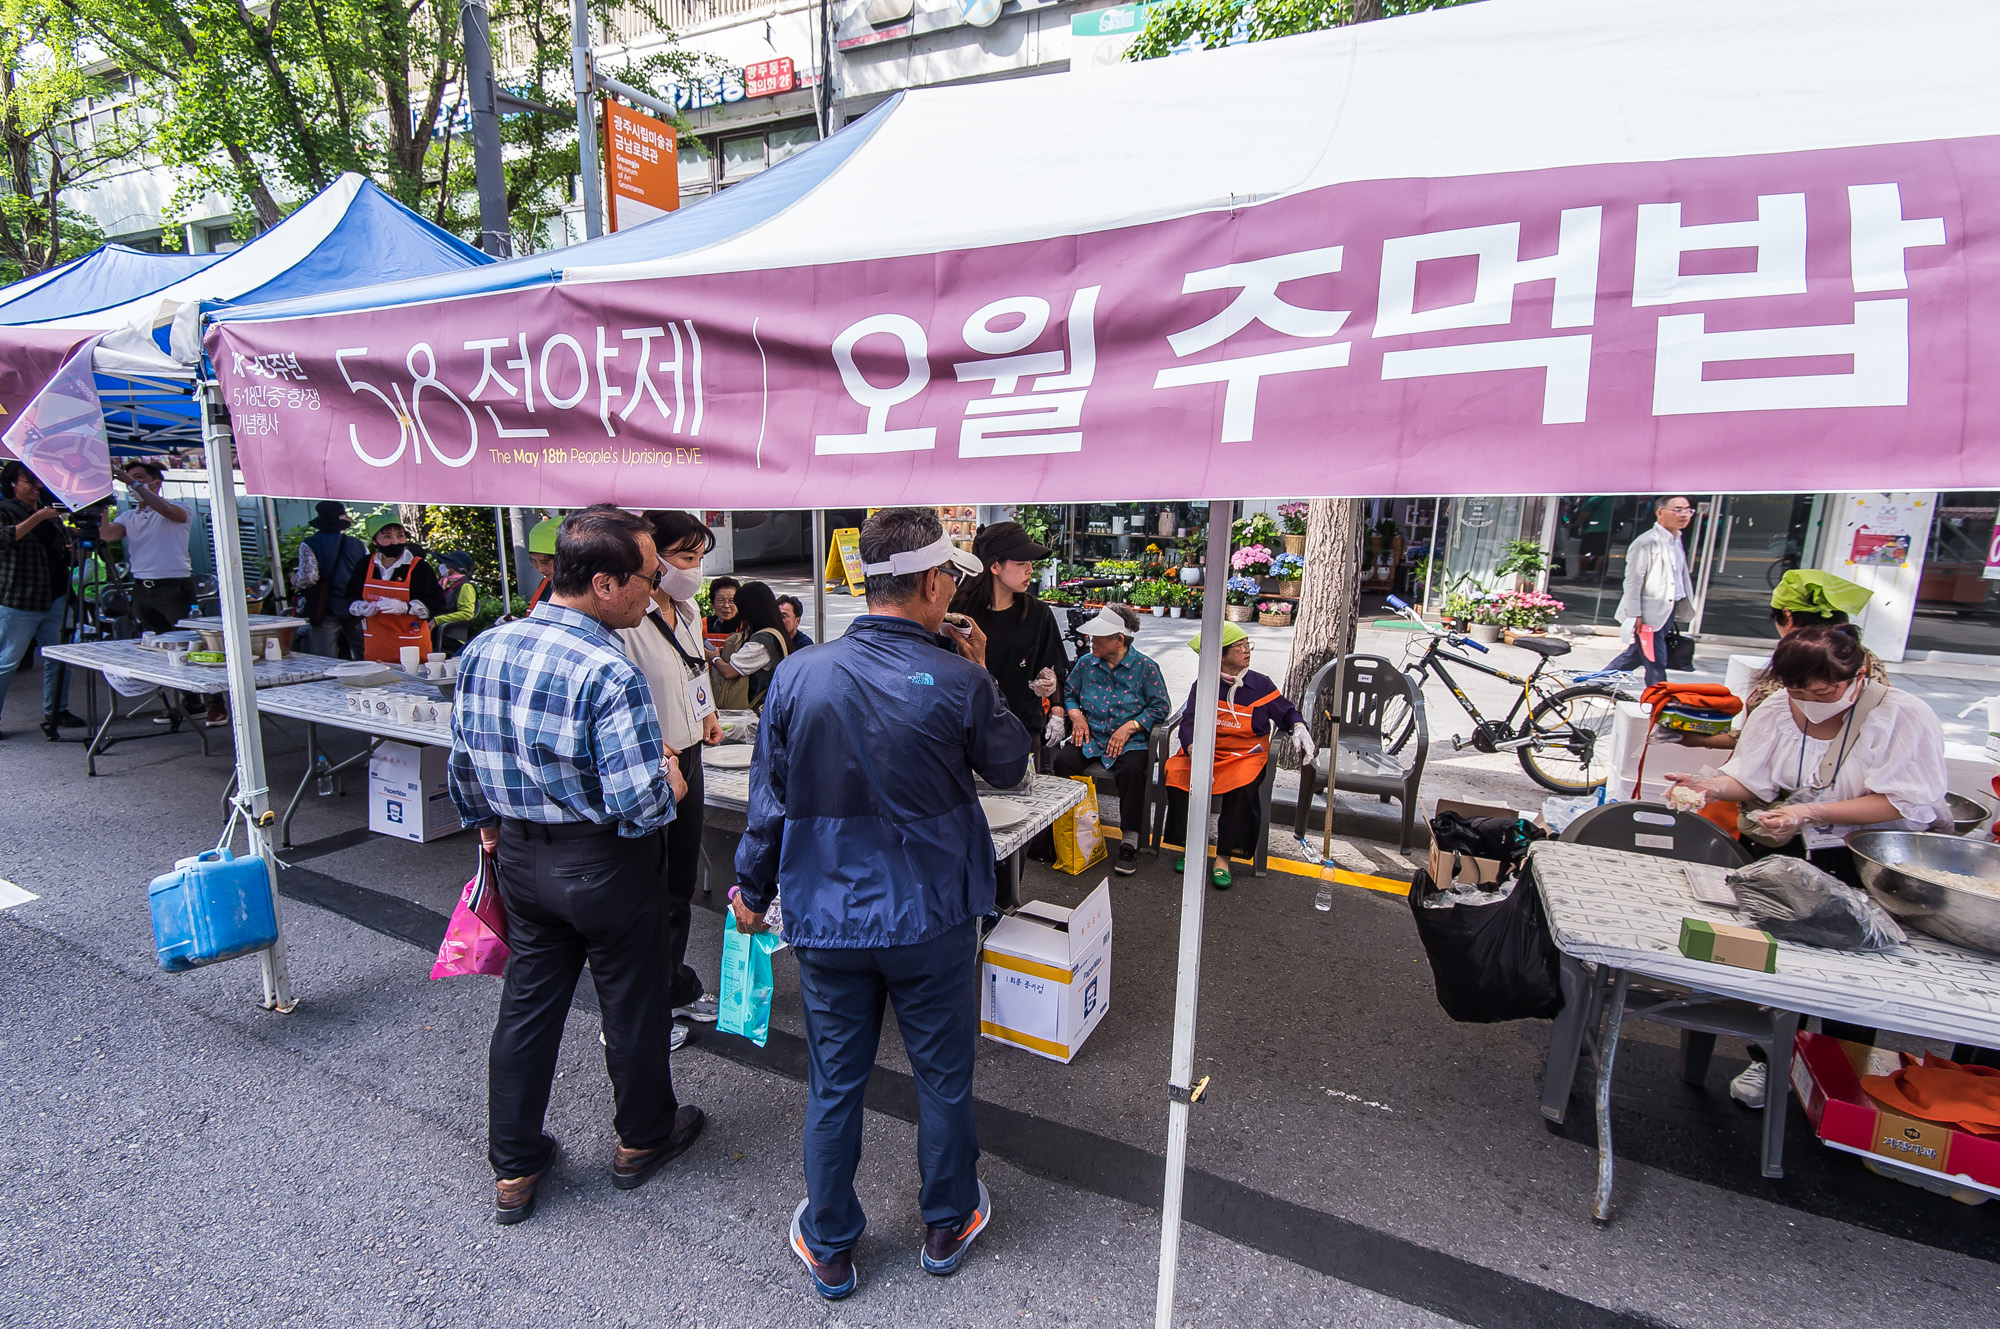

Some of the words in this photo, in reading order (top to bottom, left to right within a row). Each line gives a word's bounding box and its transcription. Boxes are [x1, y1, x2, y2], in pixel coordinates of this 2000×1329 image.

[746, 58, 790, 80] 광주동구
[779, 74, 791, 88] 2F
[613, 114, 674, 153] 광주시립미술관
[614, 133, 659, 164] 금남로분관
[616, 153, 640, 169] Gwangju
[616, 162, 639, 176] Museum
[617, 172, 624, 180] of
[623, 173, 632, 182] Art
[617, 180, 645, 195] Geumnamro
[815, 285, 1101, 458] 오월
[1153, 182, 1946, 443] 주먹밥
[463, 319, 704, 438] 전야제
[236, 412, 280, 436] 기념행사
[489, 449, 511, 464] The
[513, 449, 539, 467] May
[543, 448, 567, 464] 18th
[570, 446, 619, 467] People's
[622, 449, 672, 468] Uprising
[675, 448, 703, 464] EVE
[383, 786, 407, 797] PaperMax
[1082, 956, 1102, 981] PaperMax
